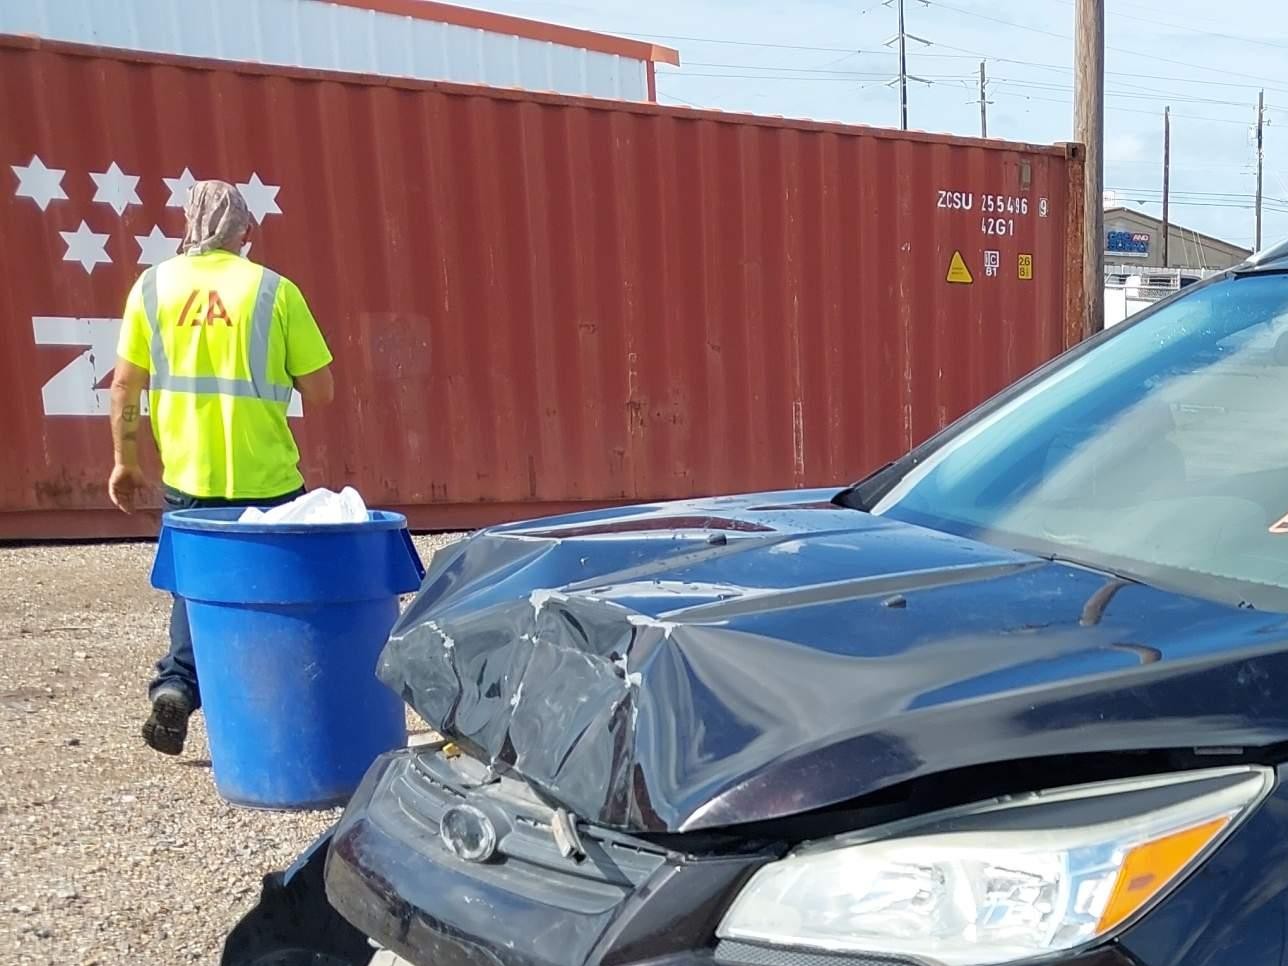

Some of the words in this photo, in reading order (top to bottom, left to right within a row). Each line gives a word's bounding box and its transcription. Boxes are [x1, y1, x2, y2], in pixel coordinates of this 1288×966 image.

[937, 190, 973, 210] ZCSU
[981, 194, 1028, 214] 255496
[981, 217, 1014, 237] 42G1
